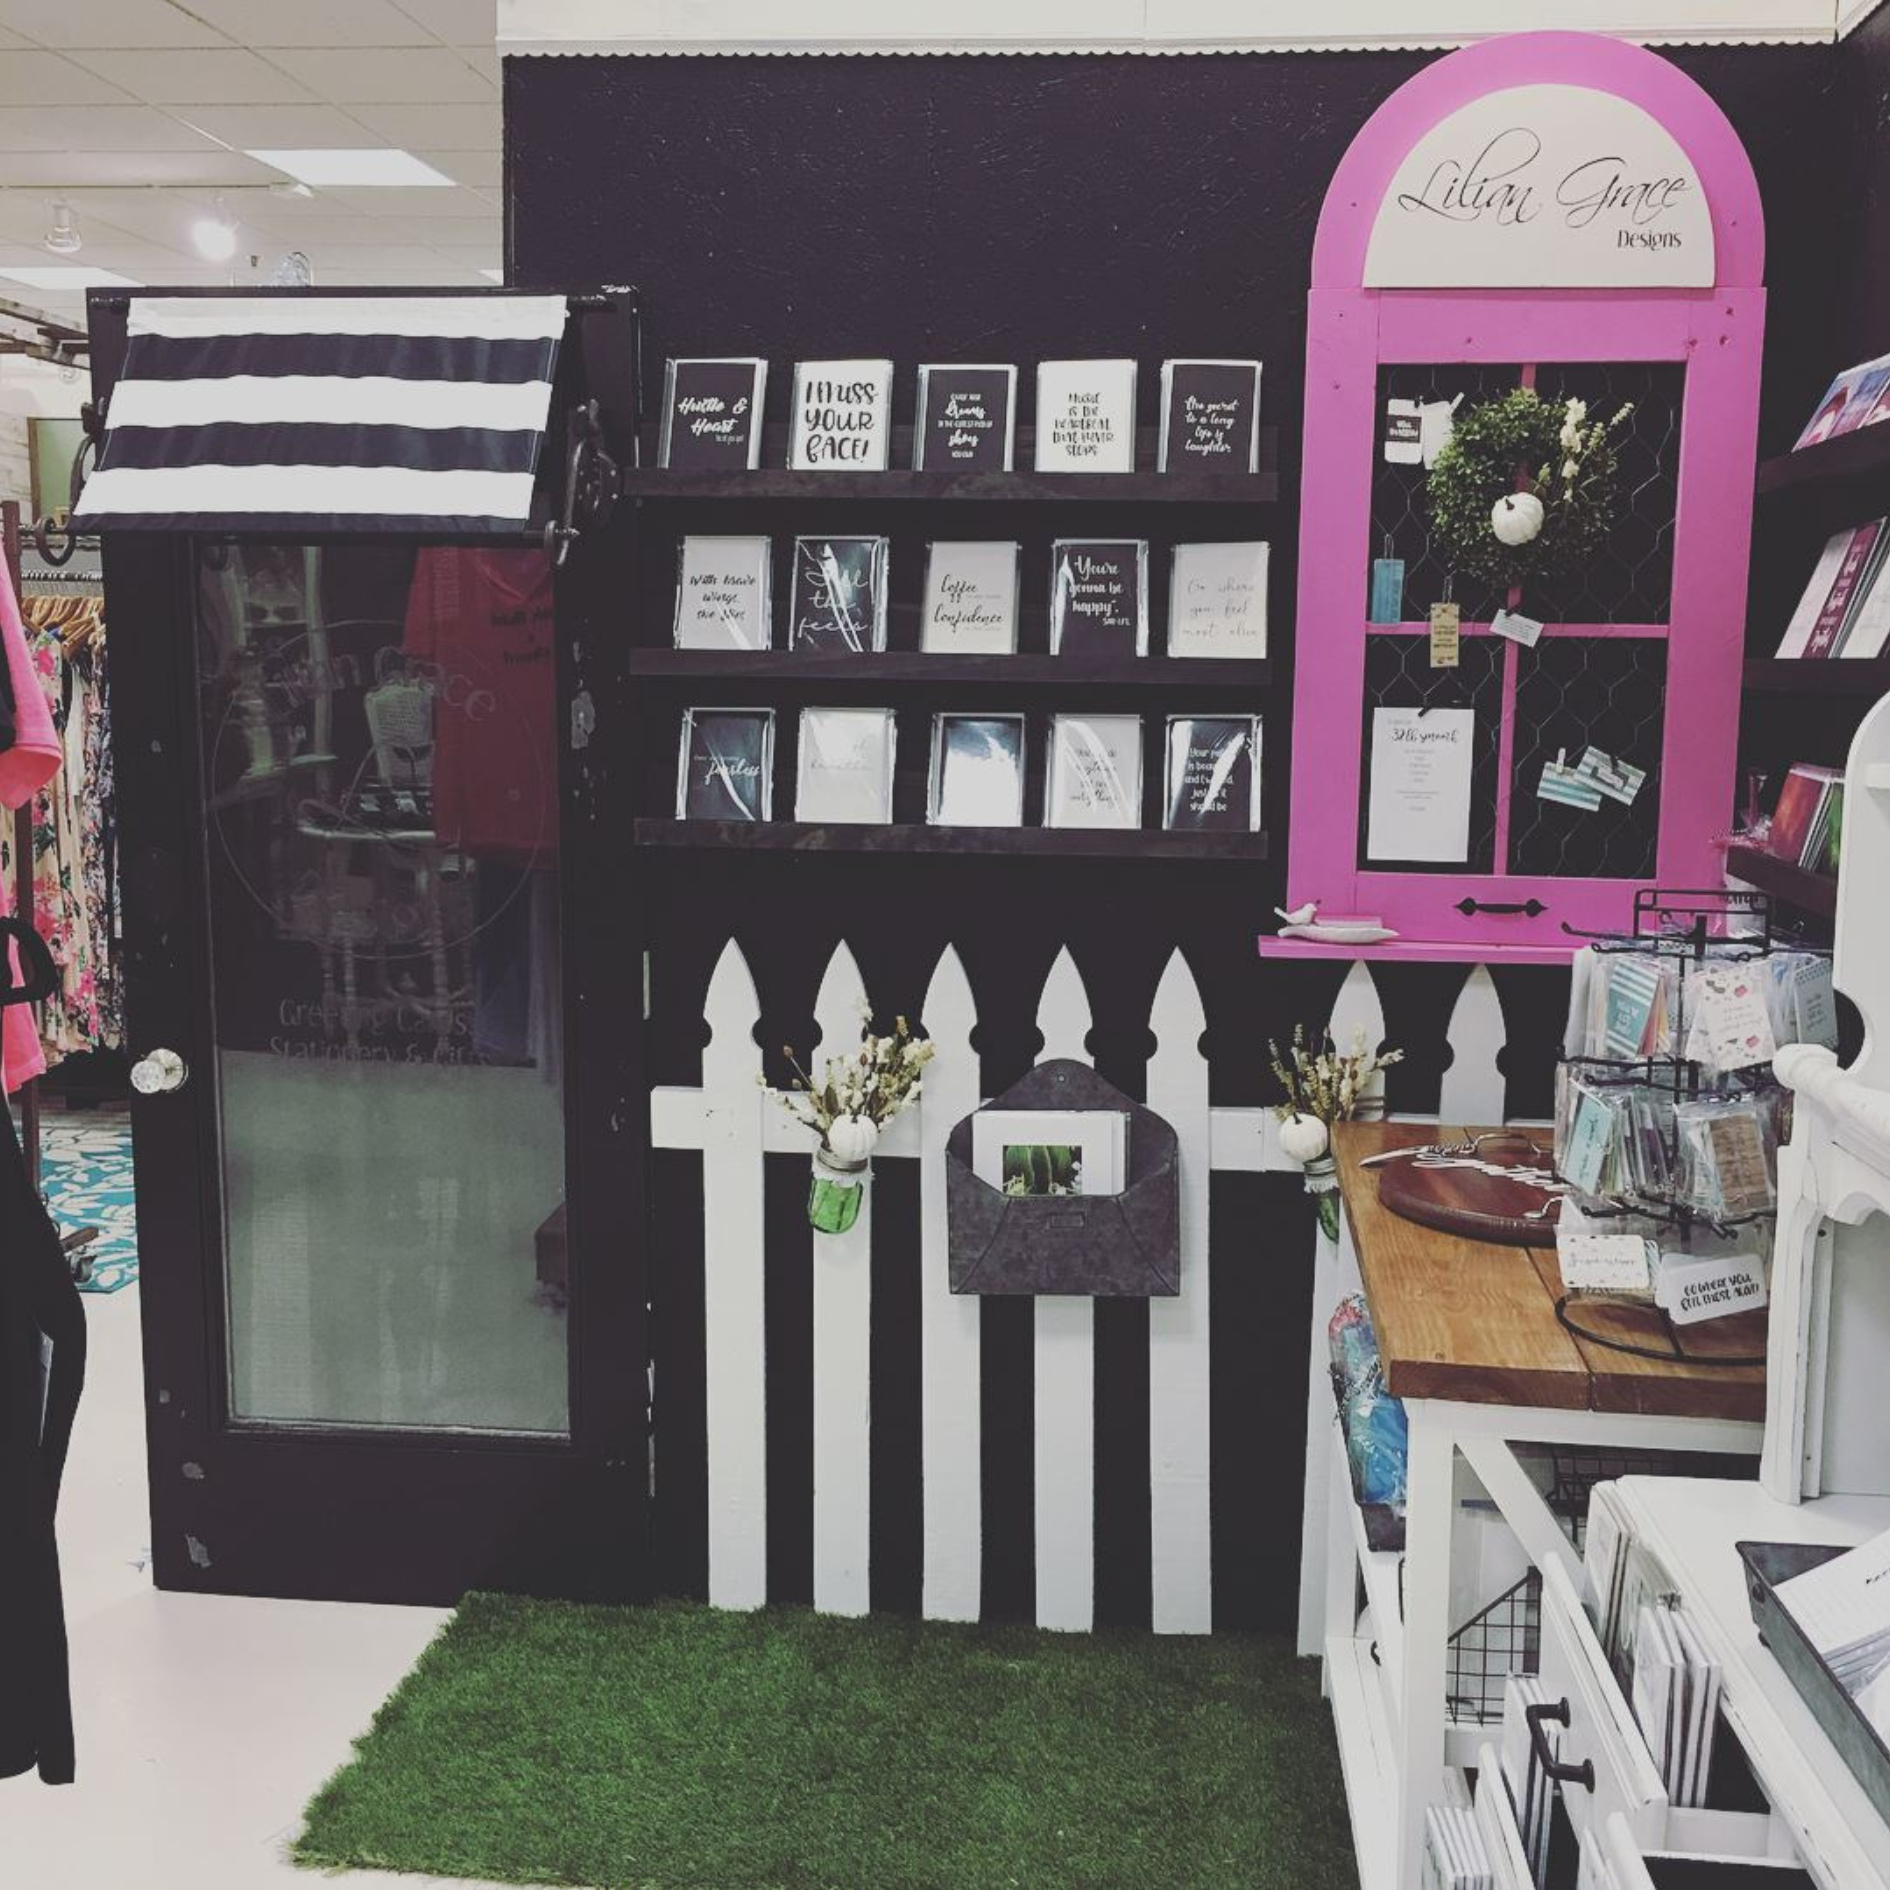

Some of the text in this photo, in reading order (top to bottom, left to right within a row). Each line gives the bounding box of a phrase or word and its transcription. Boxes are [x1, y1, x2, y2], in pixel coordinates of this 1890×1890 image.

[1398, 127, 1691, 228] Lilian Grace
[1617, 229, 1682, 250] Designs
[678, 396, 748, 415] Hustle &
[691, 418, 739, 437] Heart
[940, 573, 978, 604] Coffee
[934, 603, 1003, 634] Confidence
[703, 757, 760, 786] ferless
